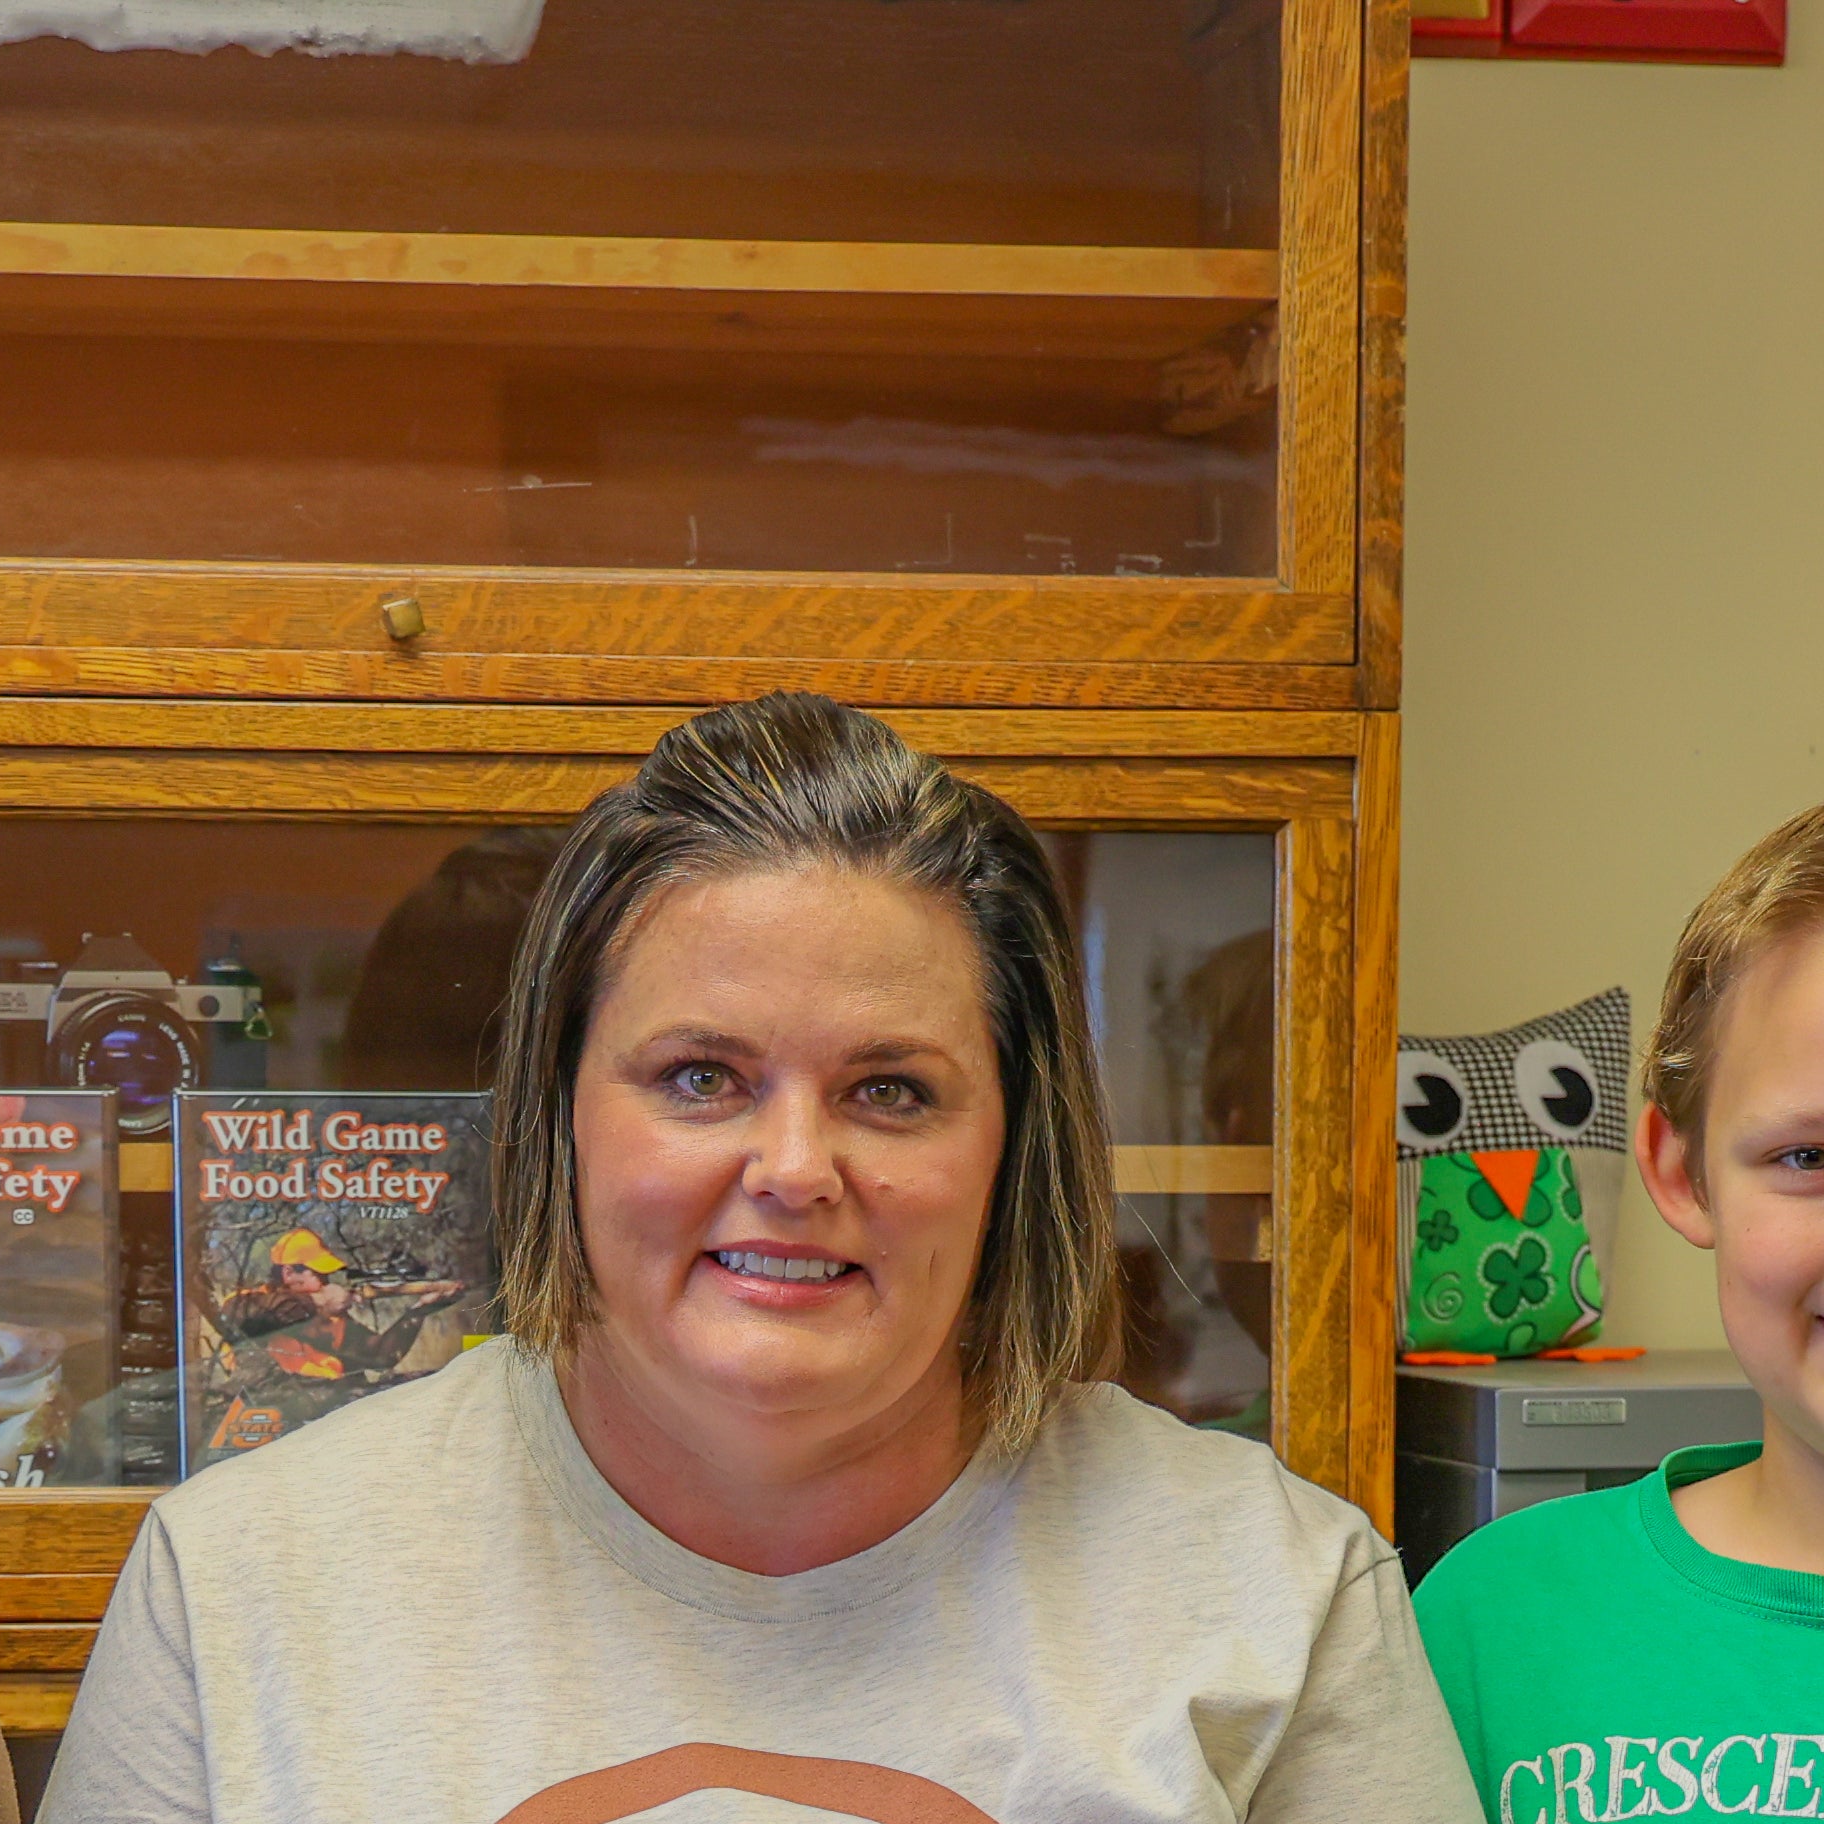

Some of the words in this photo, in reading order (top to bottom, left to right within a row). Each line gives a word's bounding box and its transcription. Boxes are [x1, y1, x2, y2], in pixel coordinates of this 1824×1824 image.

[206, 1112, 312, 1151] Wild
[325, 1113, 445, 1151] Game
[202, 1161, 308, 1199] Food
[319, 1160, 445, 1210] Safety
